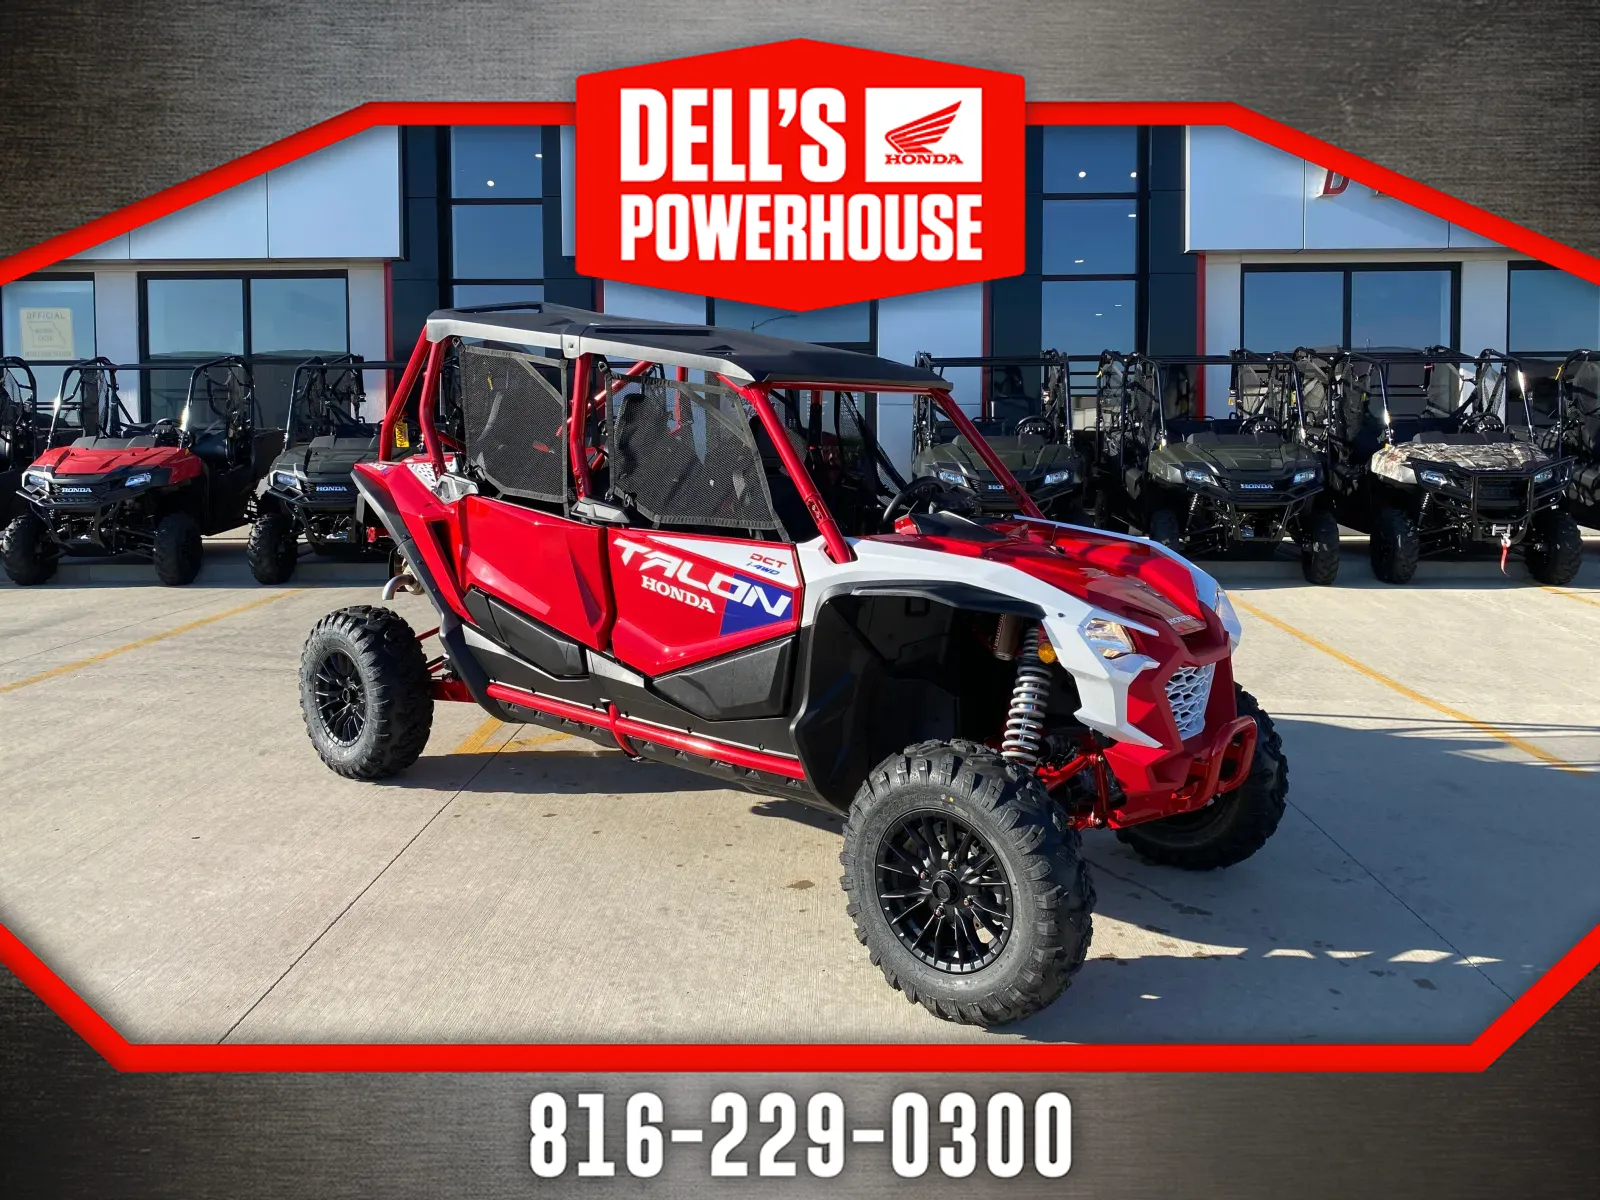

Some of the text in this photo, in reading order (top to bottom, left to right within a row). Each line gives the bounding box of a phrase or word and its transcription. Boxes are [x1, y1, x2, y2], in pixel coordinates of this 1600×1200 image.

[26, 311, 67, 320] OFFICIAL
[750, 552, 787, 569] DCT
[613, 538, 792, 618] TALON
[641, 575, 716, 615] HONDA
[1165, 614, 1197, 625] HONDA
